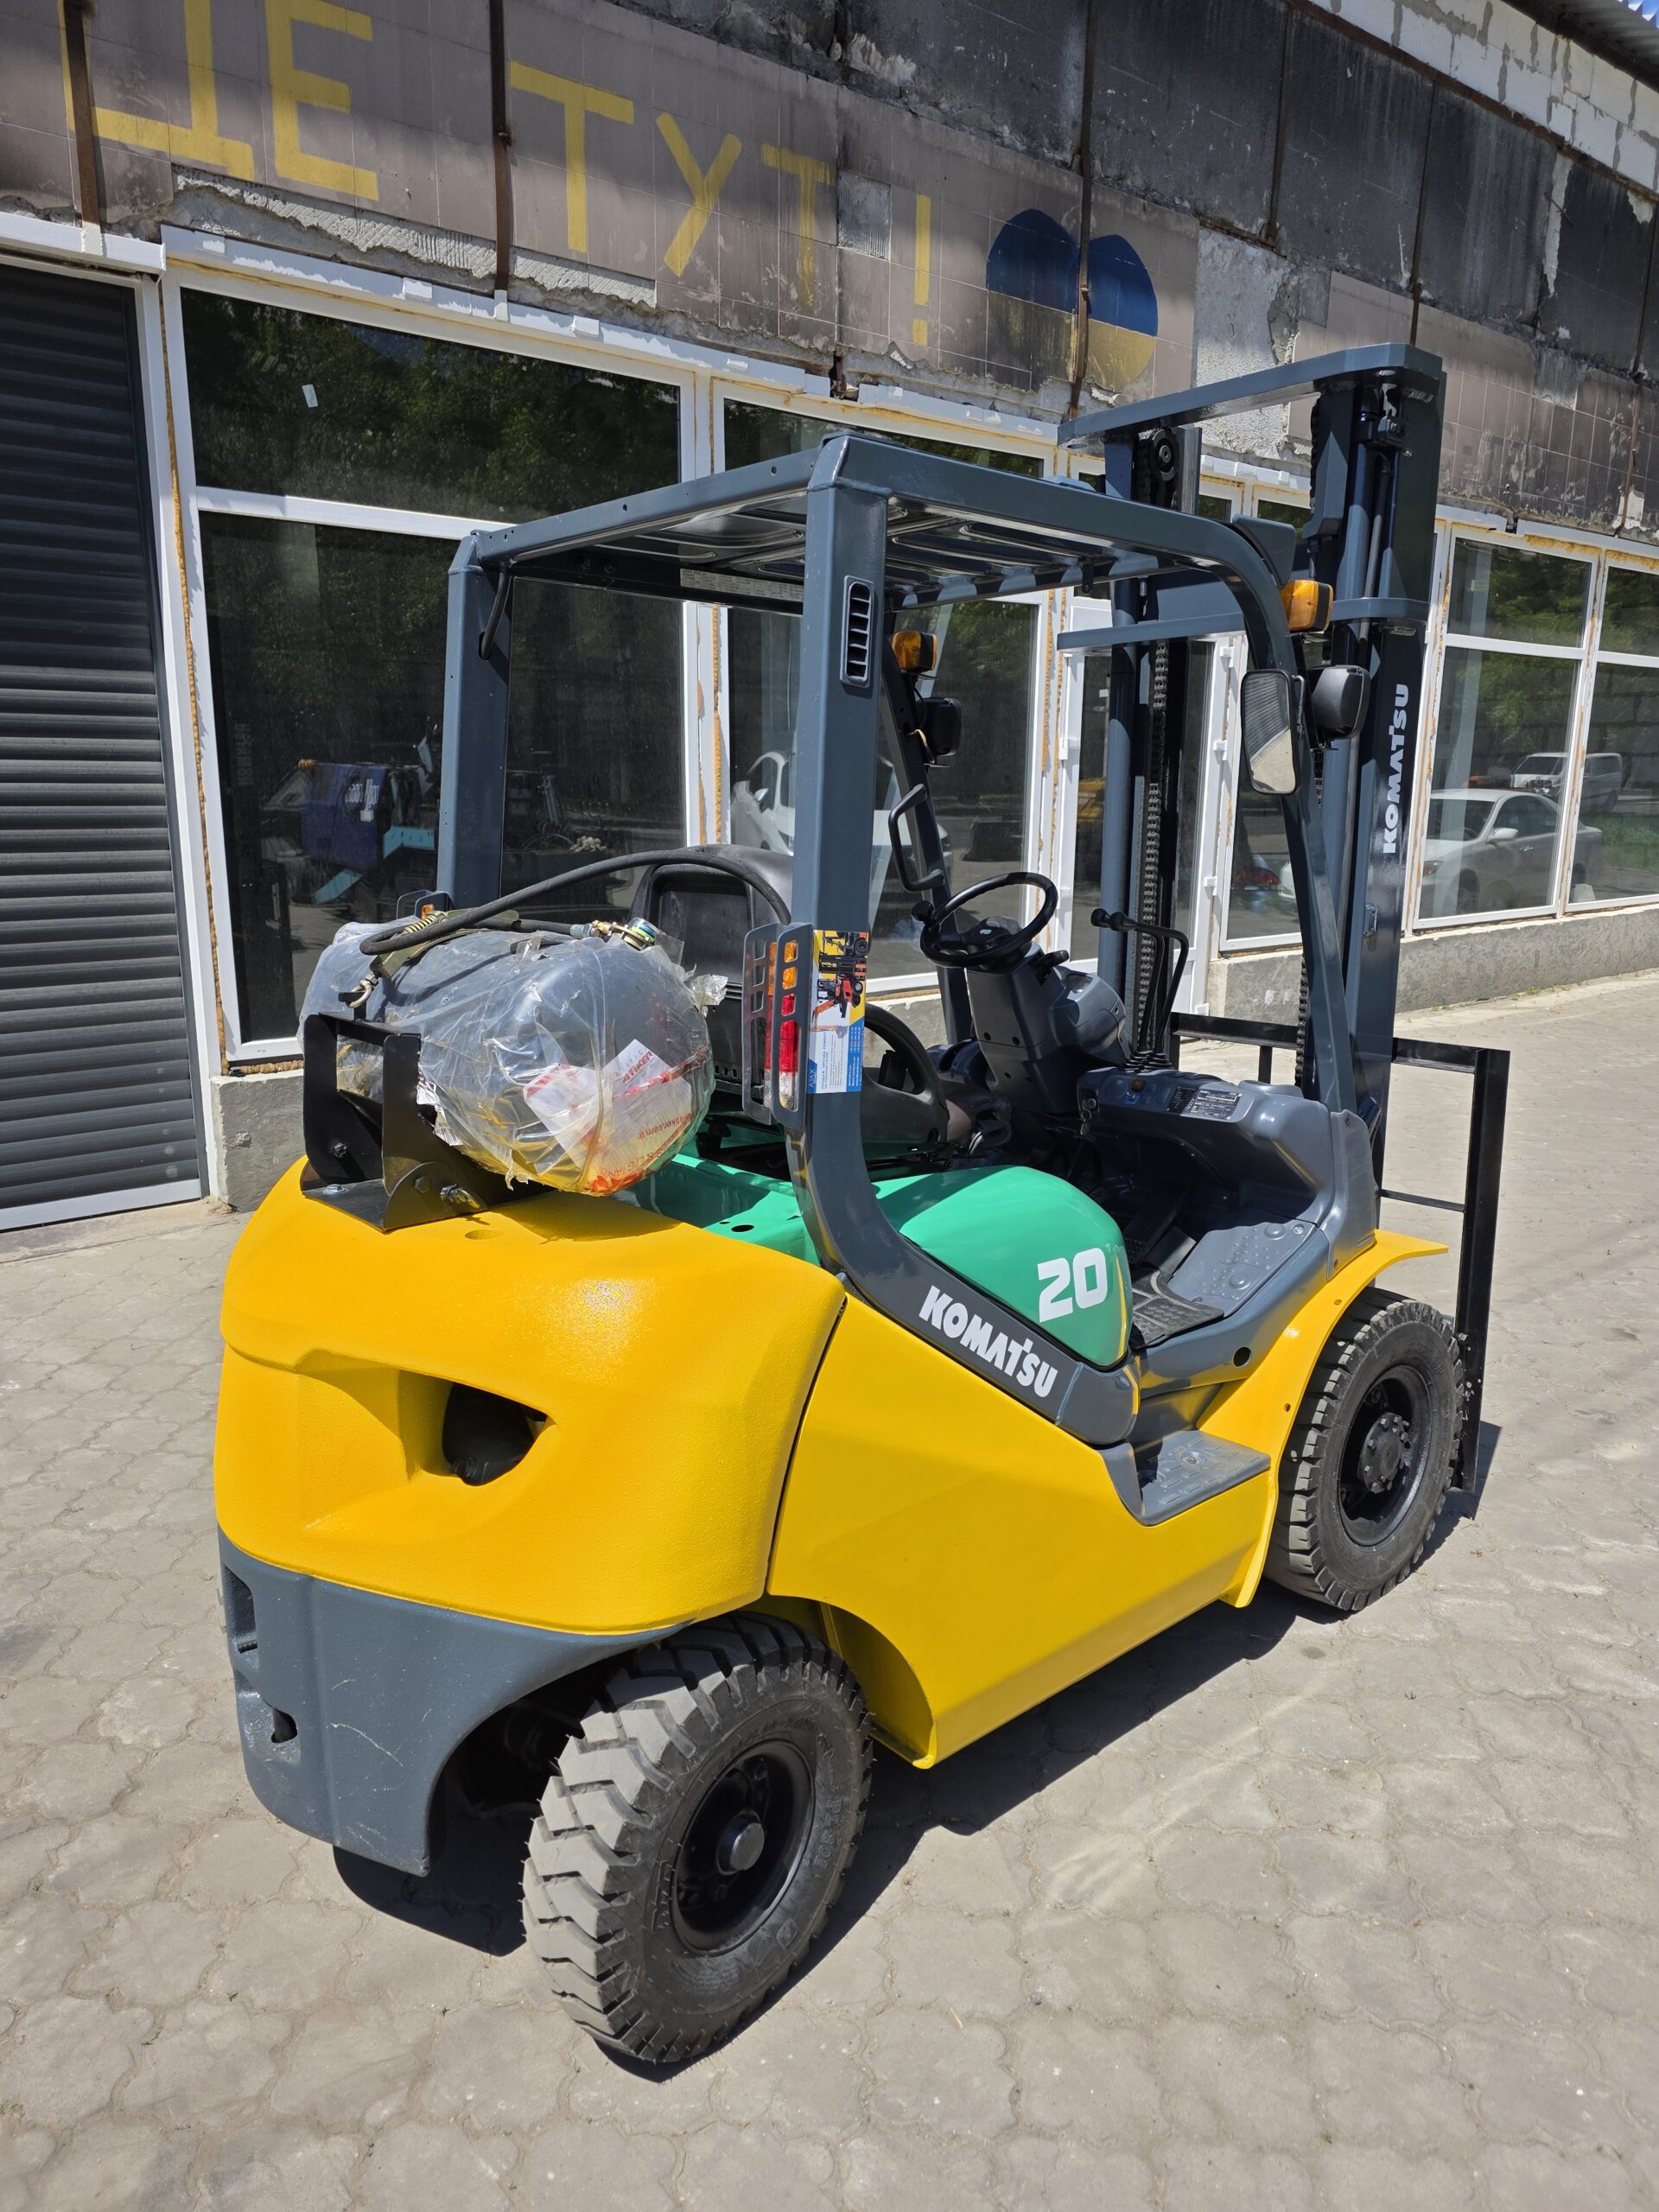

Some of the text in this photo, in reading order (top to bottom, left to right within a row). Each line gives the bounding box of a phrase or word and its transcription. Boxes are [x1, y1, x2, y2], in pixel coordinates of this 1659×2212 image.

[1382, 683, 1409, 854] KOMATSU
[918, 1285, 1058, 1398] KOMATSU
[1037, 1248, 1108, 1323] 20
